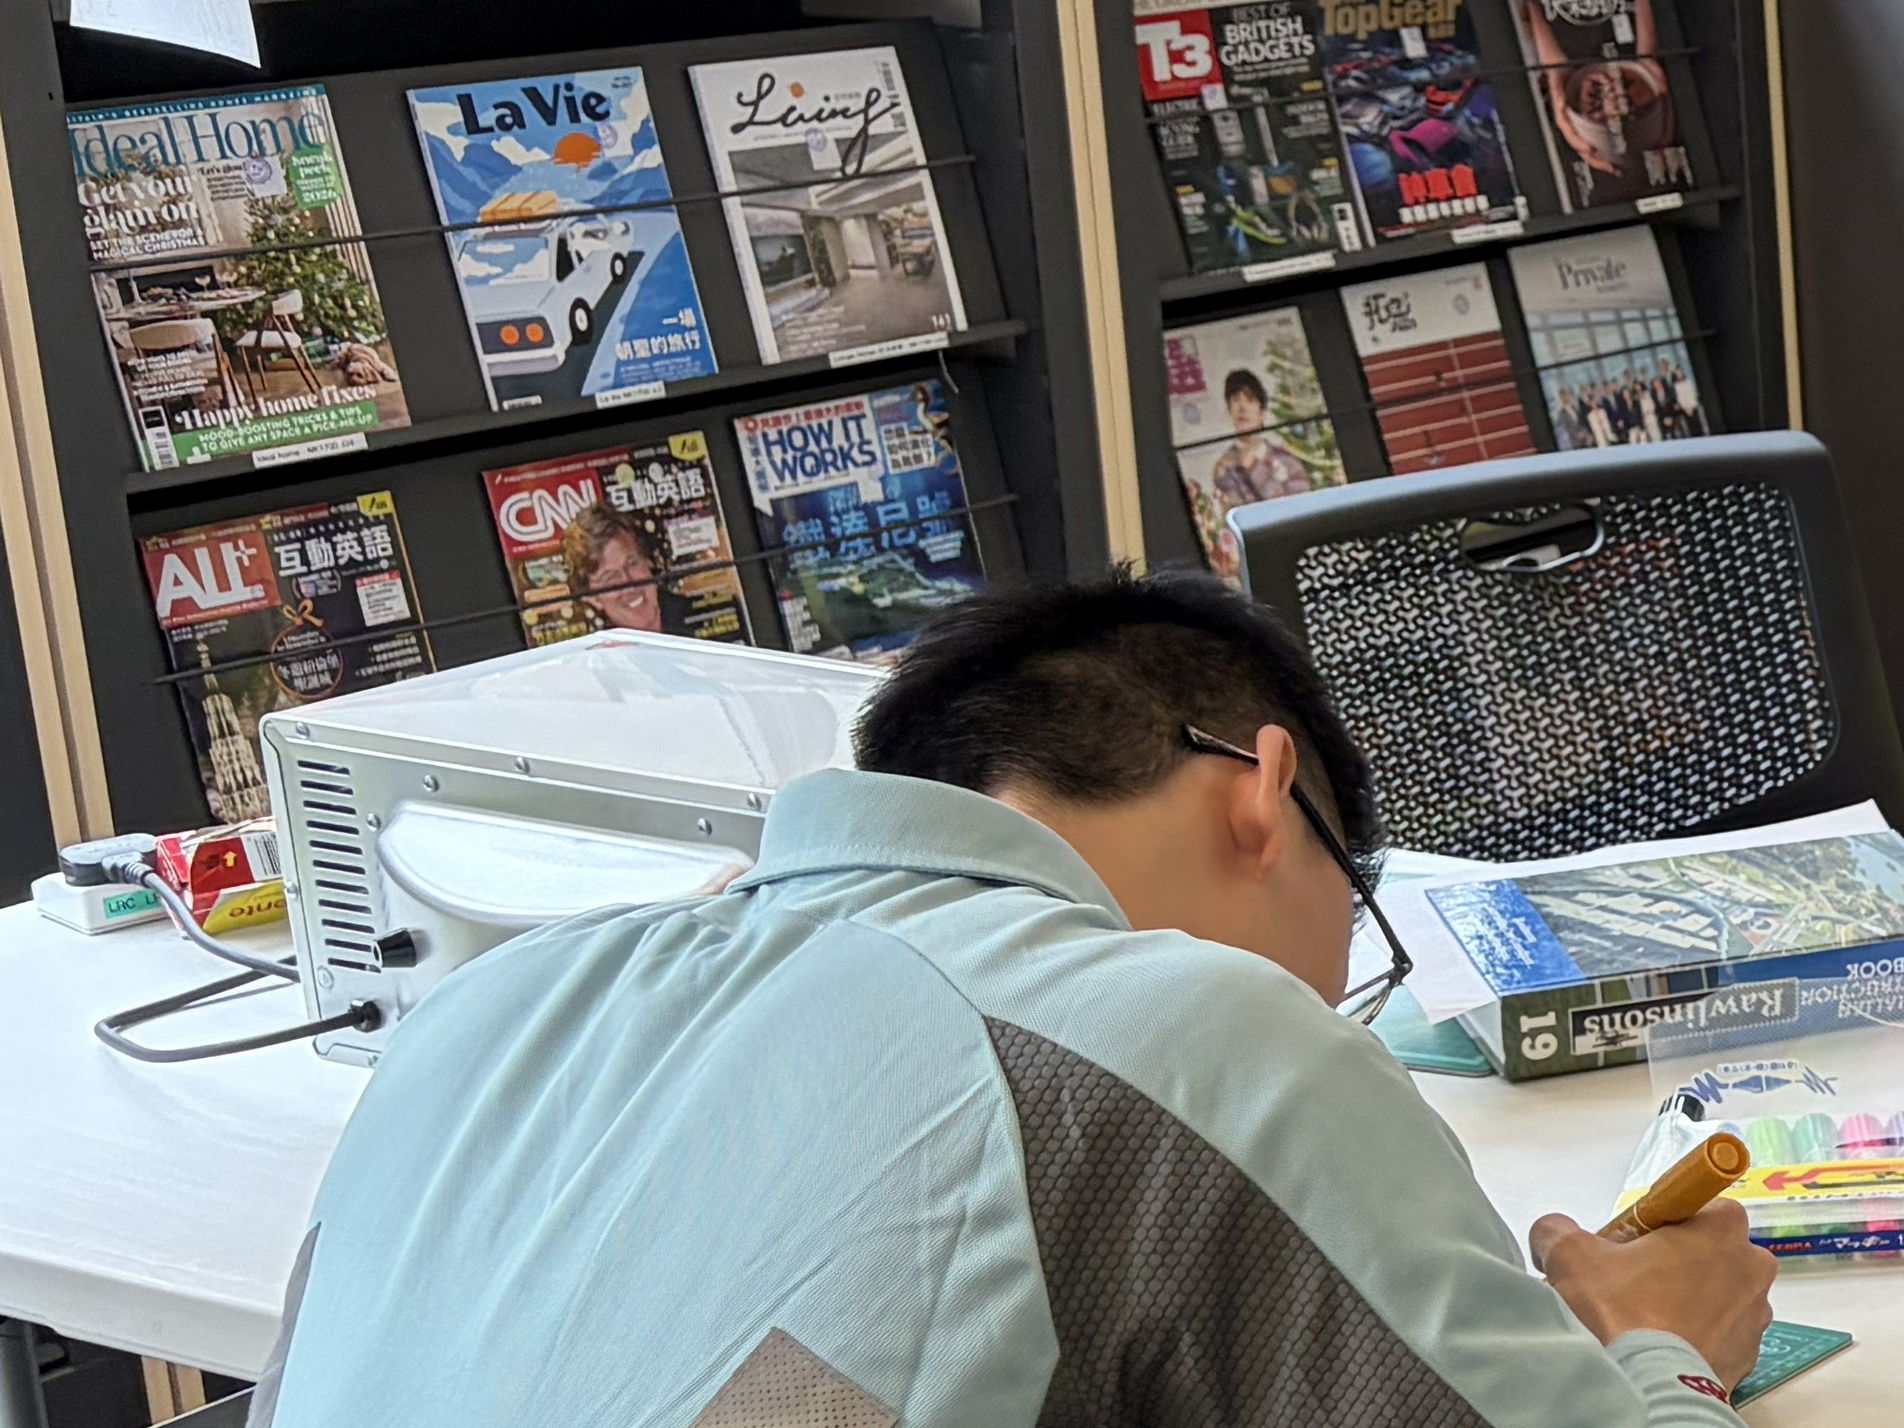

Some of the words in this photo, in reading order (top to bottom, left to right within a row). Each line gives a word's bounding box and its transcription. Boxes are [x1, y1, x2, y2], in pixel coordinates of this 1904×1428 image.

[1135, 21, 1212, 83] T3
[1220, 35, 1316, 67] GADGETS
[1224, 16, 1304, 44] BRITISH
[456, 91, 527, 137] La
[520, 81, 611, 127] Vie
[68, 117, 182, 179] Ideal
[181, 110, 326, 164] Home
[77, 177, 129, 207] Get
[83, 202, 158, 238] glam
[160, 200, 200, 224] on
[174, 403, 256, 430] Happy
[257, 392, 322, 418] home
[761, 419, 838, 456] HOW
[842, 414, 867, 443] IT
[767, 439, 877, 485] WORKS
[604, 467, 706, 513] 互動英語
[274, 524, 394, 577] 互動英語
[108, 897, 137, 914] LRC
[1519, 1010, 1559, 1061] 19
[1583, 985, 1785, 1040] Rawlinsons
